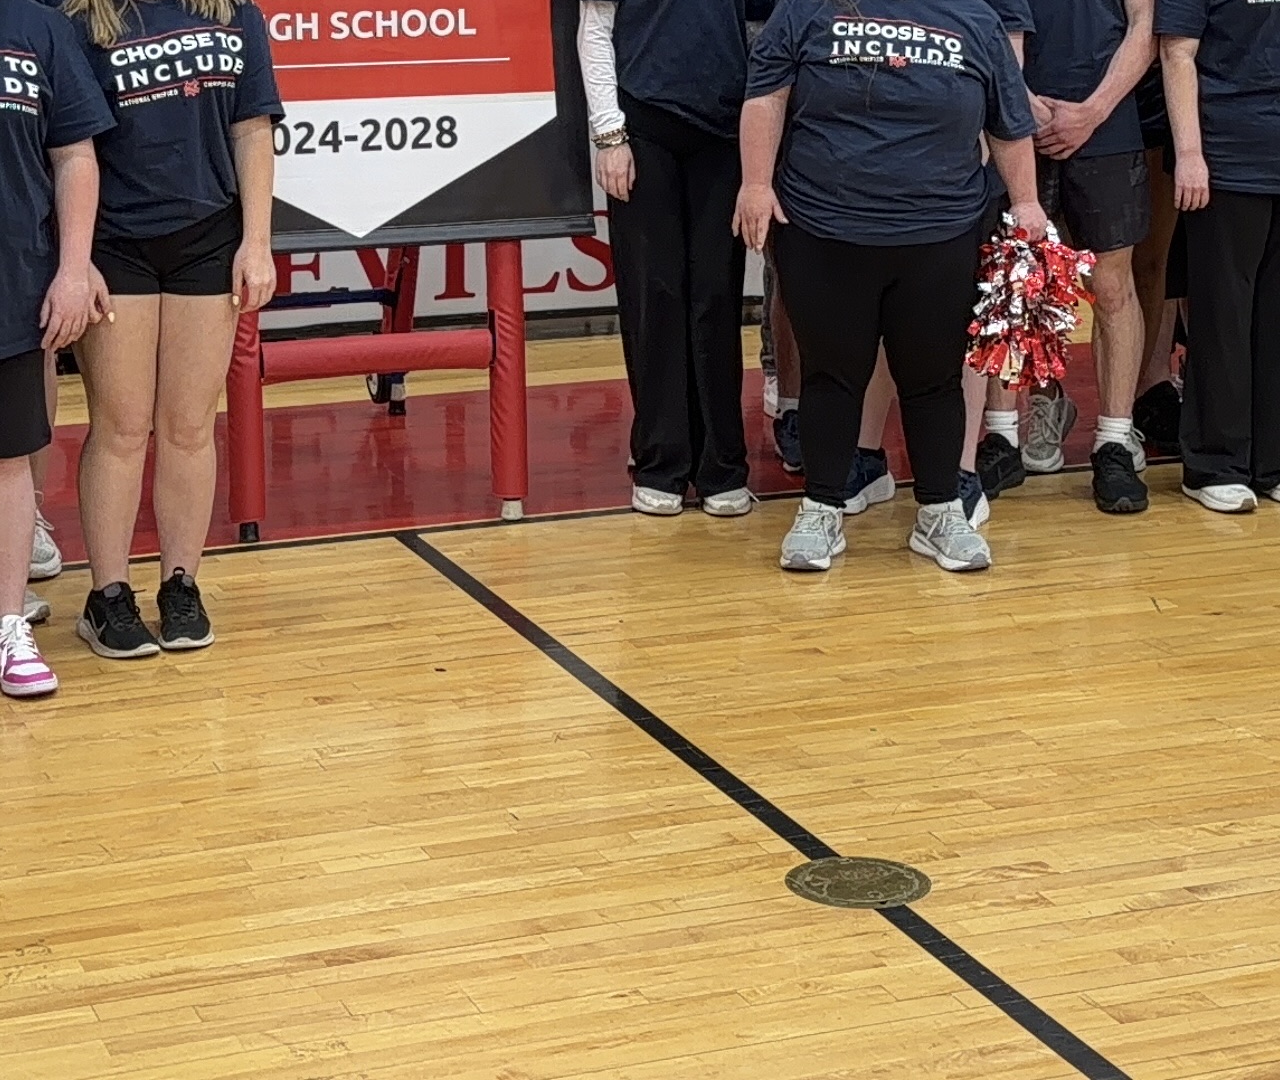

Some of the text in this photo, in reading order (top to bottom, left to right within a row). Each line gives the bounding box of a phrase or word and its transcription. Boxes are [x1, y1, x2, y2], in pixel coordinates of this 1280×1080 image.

[331, 9, 476, 39] SCHOOL
[833, 22, 961, 52] CHOOSE TO
[4, 56, 37, 76] TO
[111, 32, 242, 71] CHOOSE TO
[831, 40, 963, 65] INCLUDE
[115, 54, 243, 92] INCLUDE
[270, 111, 457, 156] 024-2028
